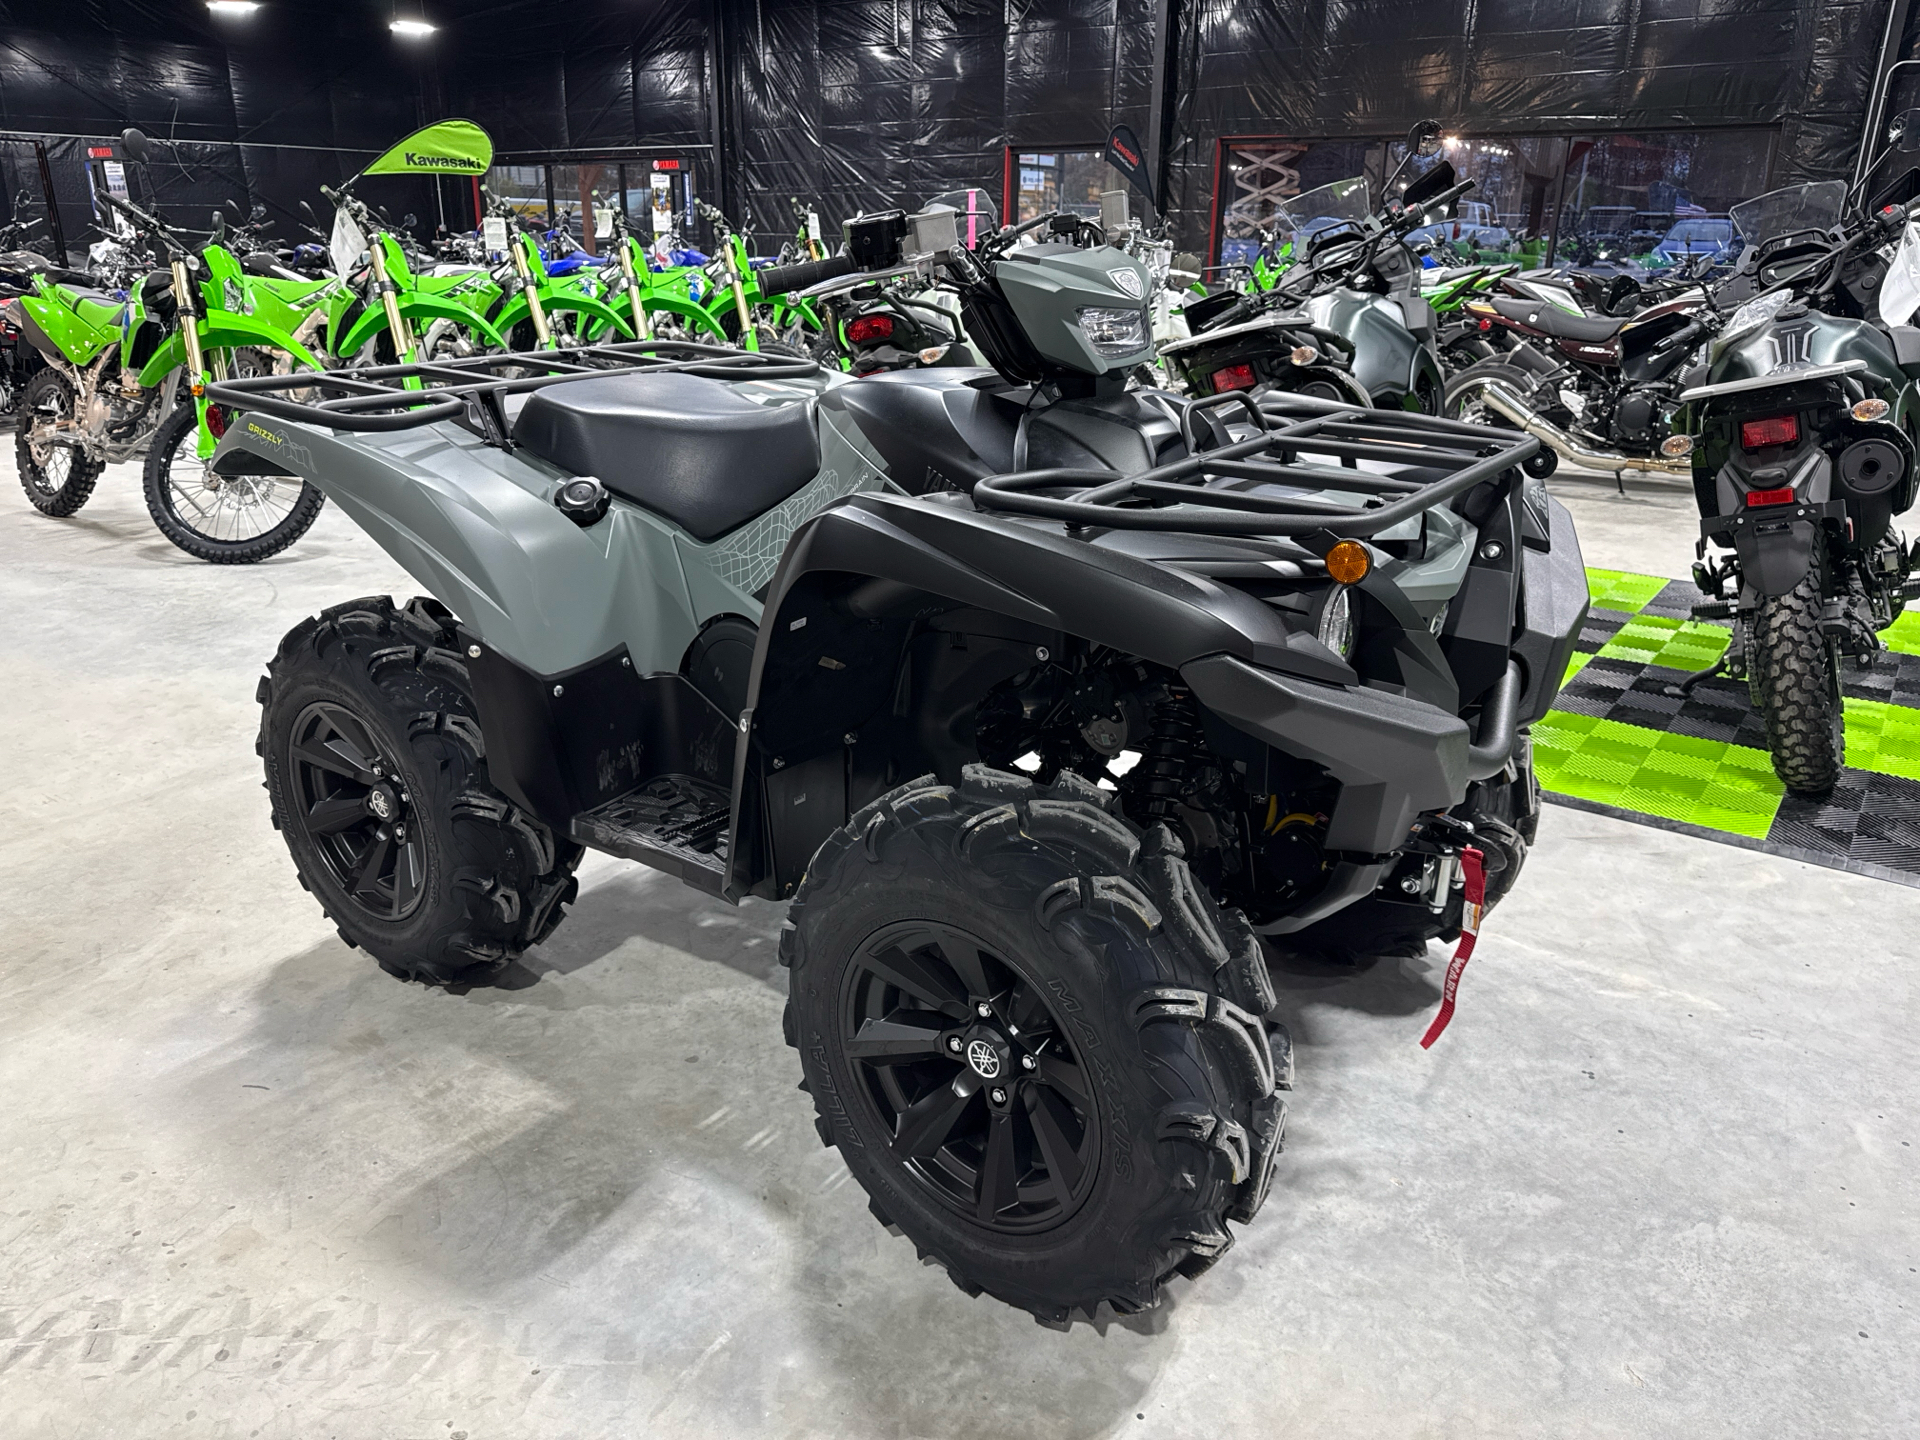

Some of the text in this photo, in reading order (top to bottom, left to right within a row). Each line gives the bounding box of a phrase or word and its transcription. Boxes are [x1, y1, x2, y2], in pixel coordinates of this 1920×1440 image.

[405, 152, 482, 169] Kawasaki
[1112, 136, 1139, 167] Kawasaki
[248, 422, 283, 446] GRIZZLY
[1446, 956, 1465, 1003] WARN
[1046, 976, 1134, 1184] MAXXIS
